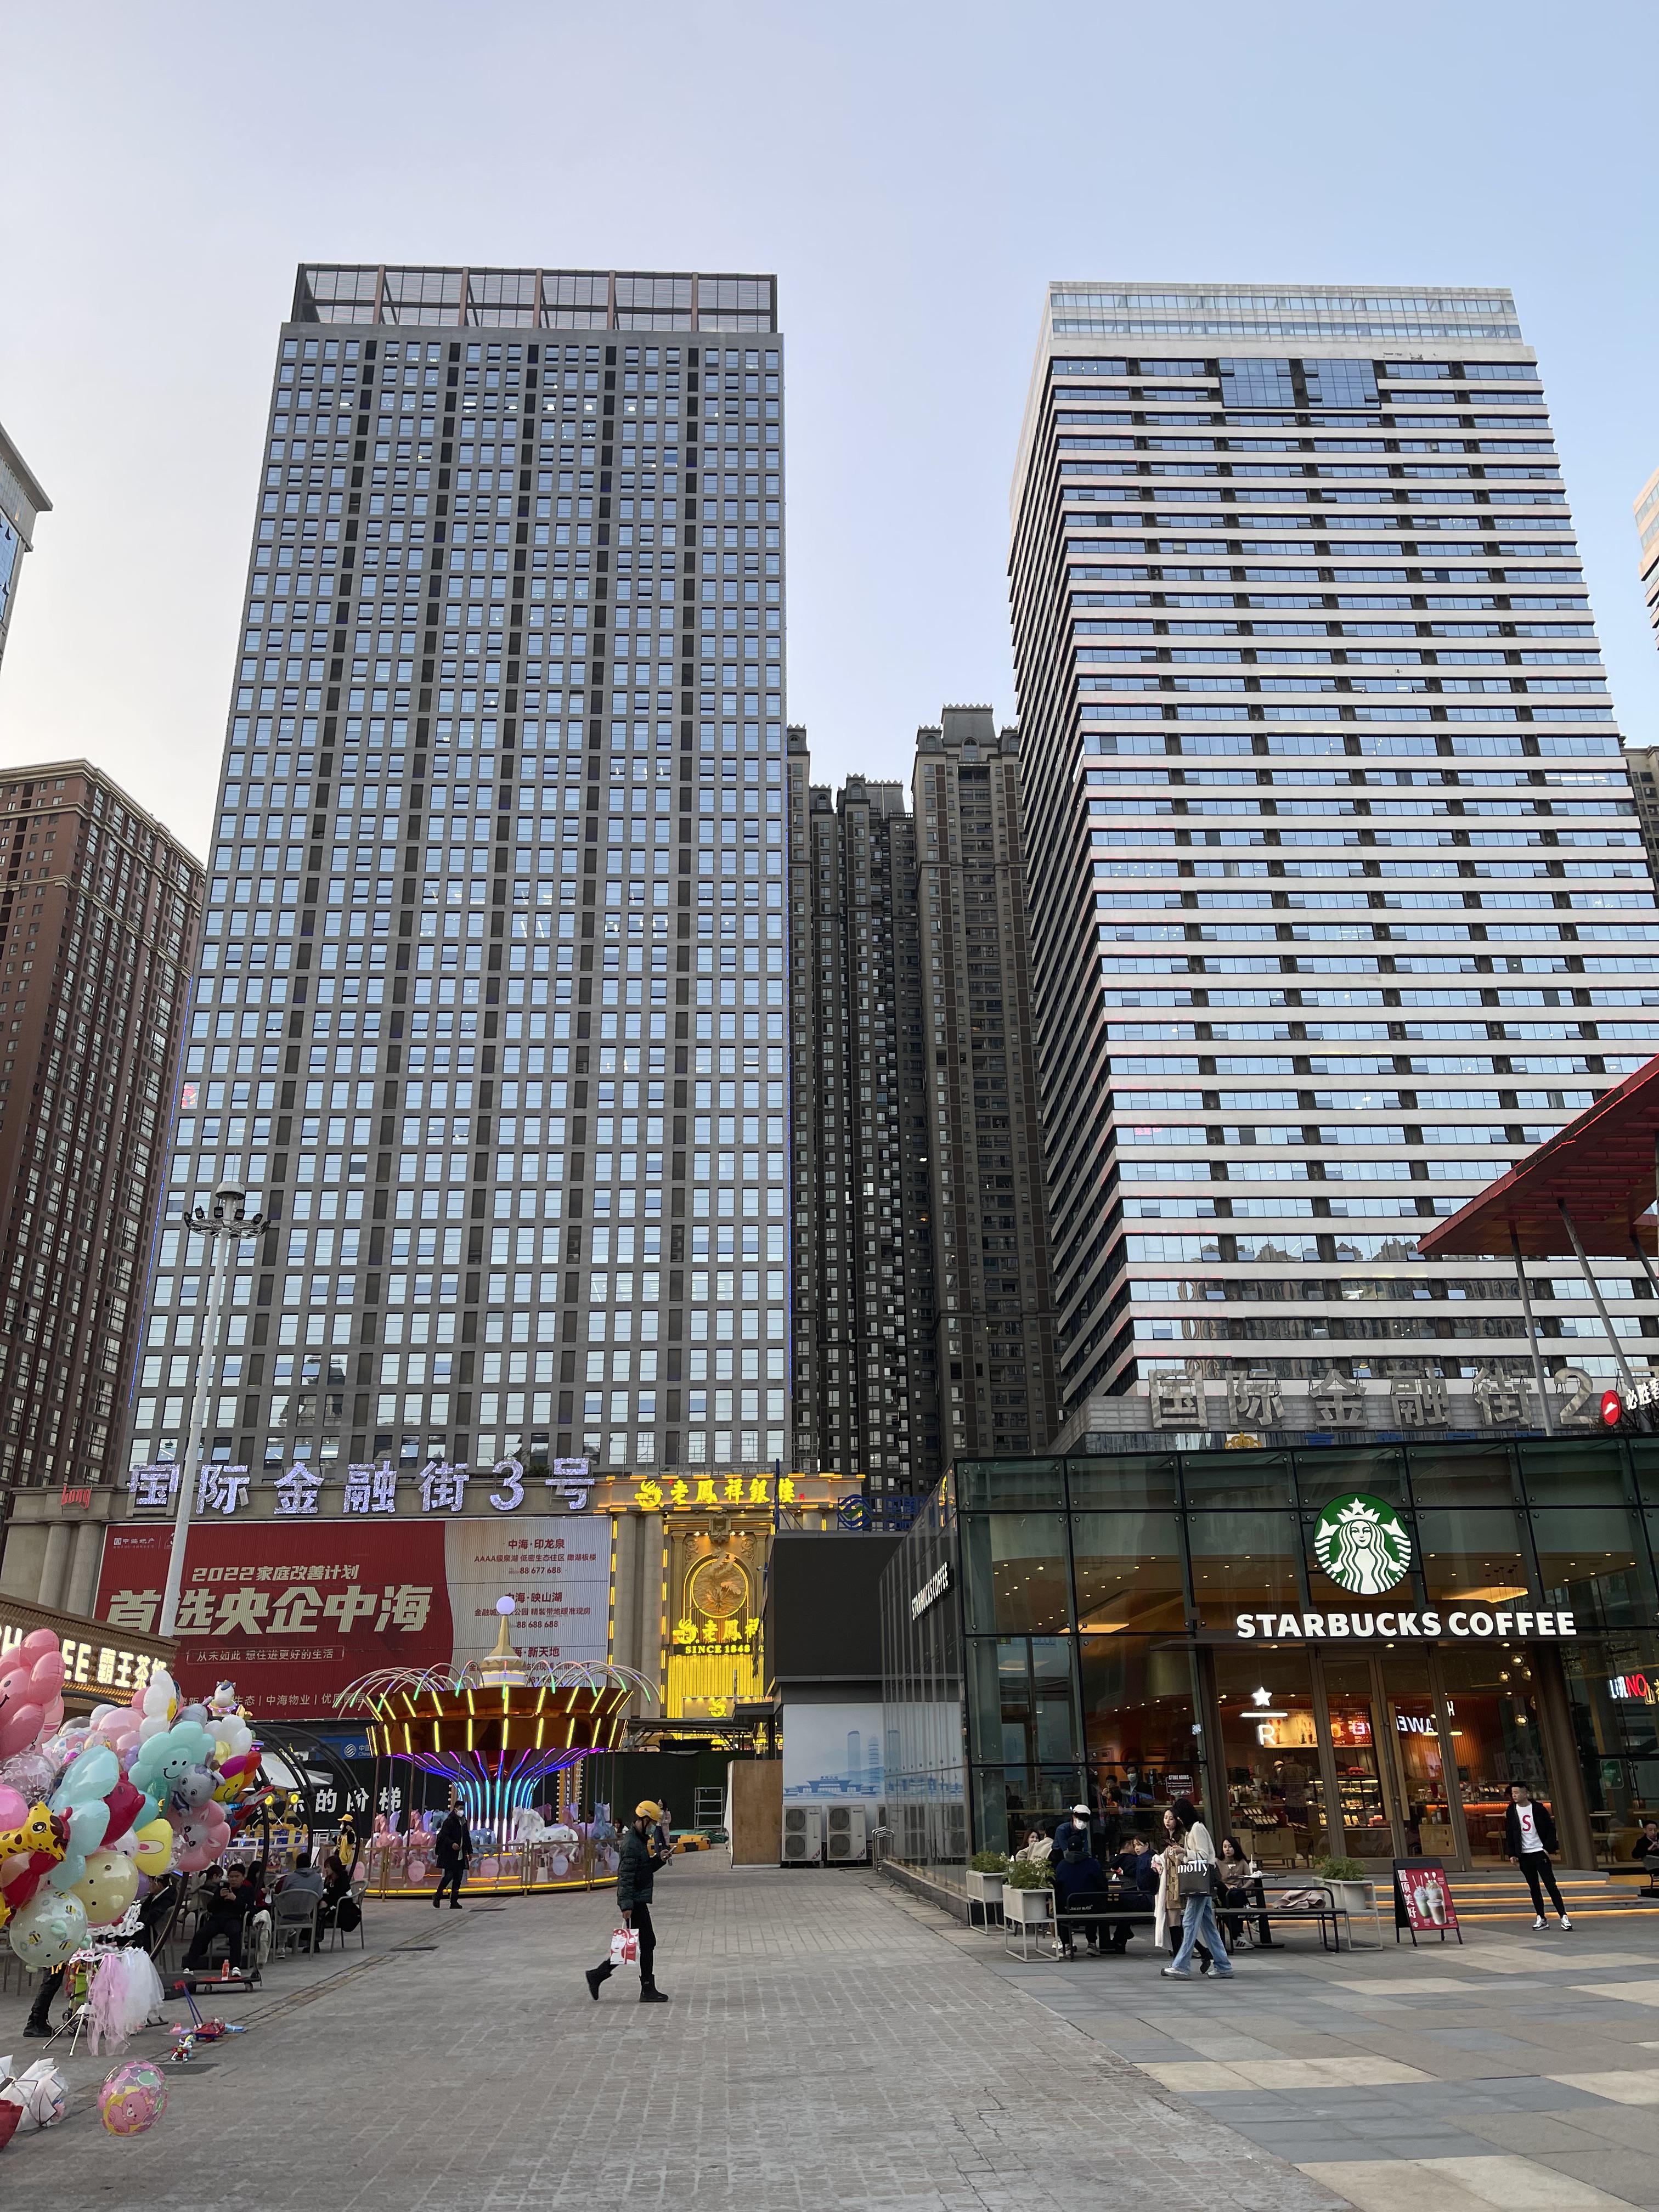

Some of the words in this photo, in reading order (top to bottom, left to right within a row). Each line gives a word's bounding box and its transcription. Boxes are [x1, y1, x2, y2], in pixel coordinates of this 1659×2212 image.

[126, 1458, 594, 1517] 国际金融街3号
[192, 1564, 360, 1582] 2022家庭改善计划
[912, 1579, 933, 1621] STARBUCKS
[933, 1561, 948, 1600] COFFEE
[106, 1584, 433, 1635] 首选央企中海
[1237, 1612, 1442, 1638] STARBUCKS
[1448, 1612, 1577, 1636] COFFEE
[196, 1650, 241, 1662] 从未如此
[245, 1649, 334, 1661] 想住进更好的生活
[685, 1645, 722, 1654] SINCE
[725, 1645, 751, 1654] 1848
[266, 1694, 311, 1706] 中海物业
[1258, 1724, 1276, 1745] R
[1522, 1814, 1531, 1832] S
